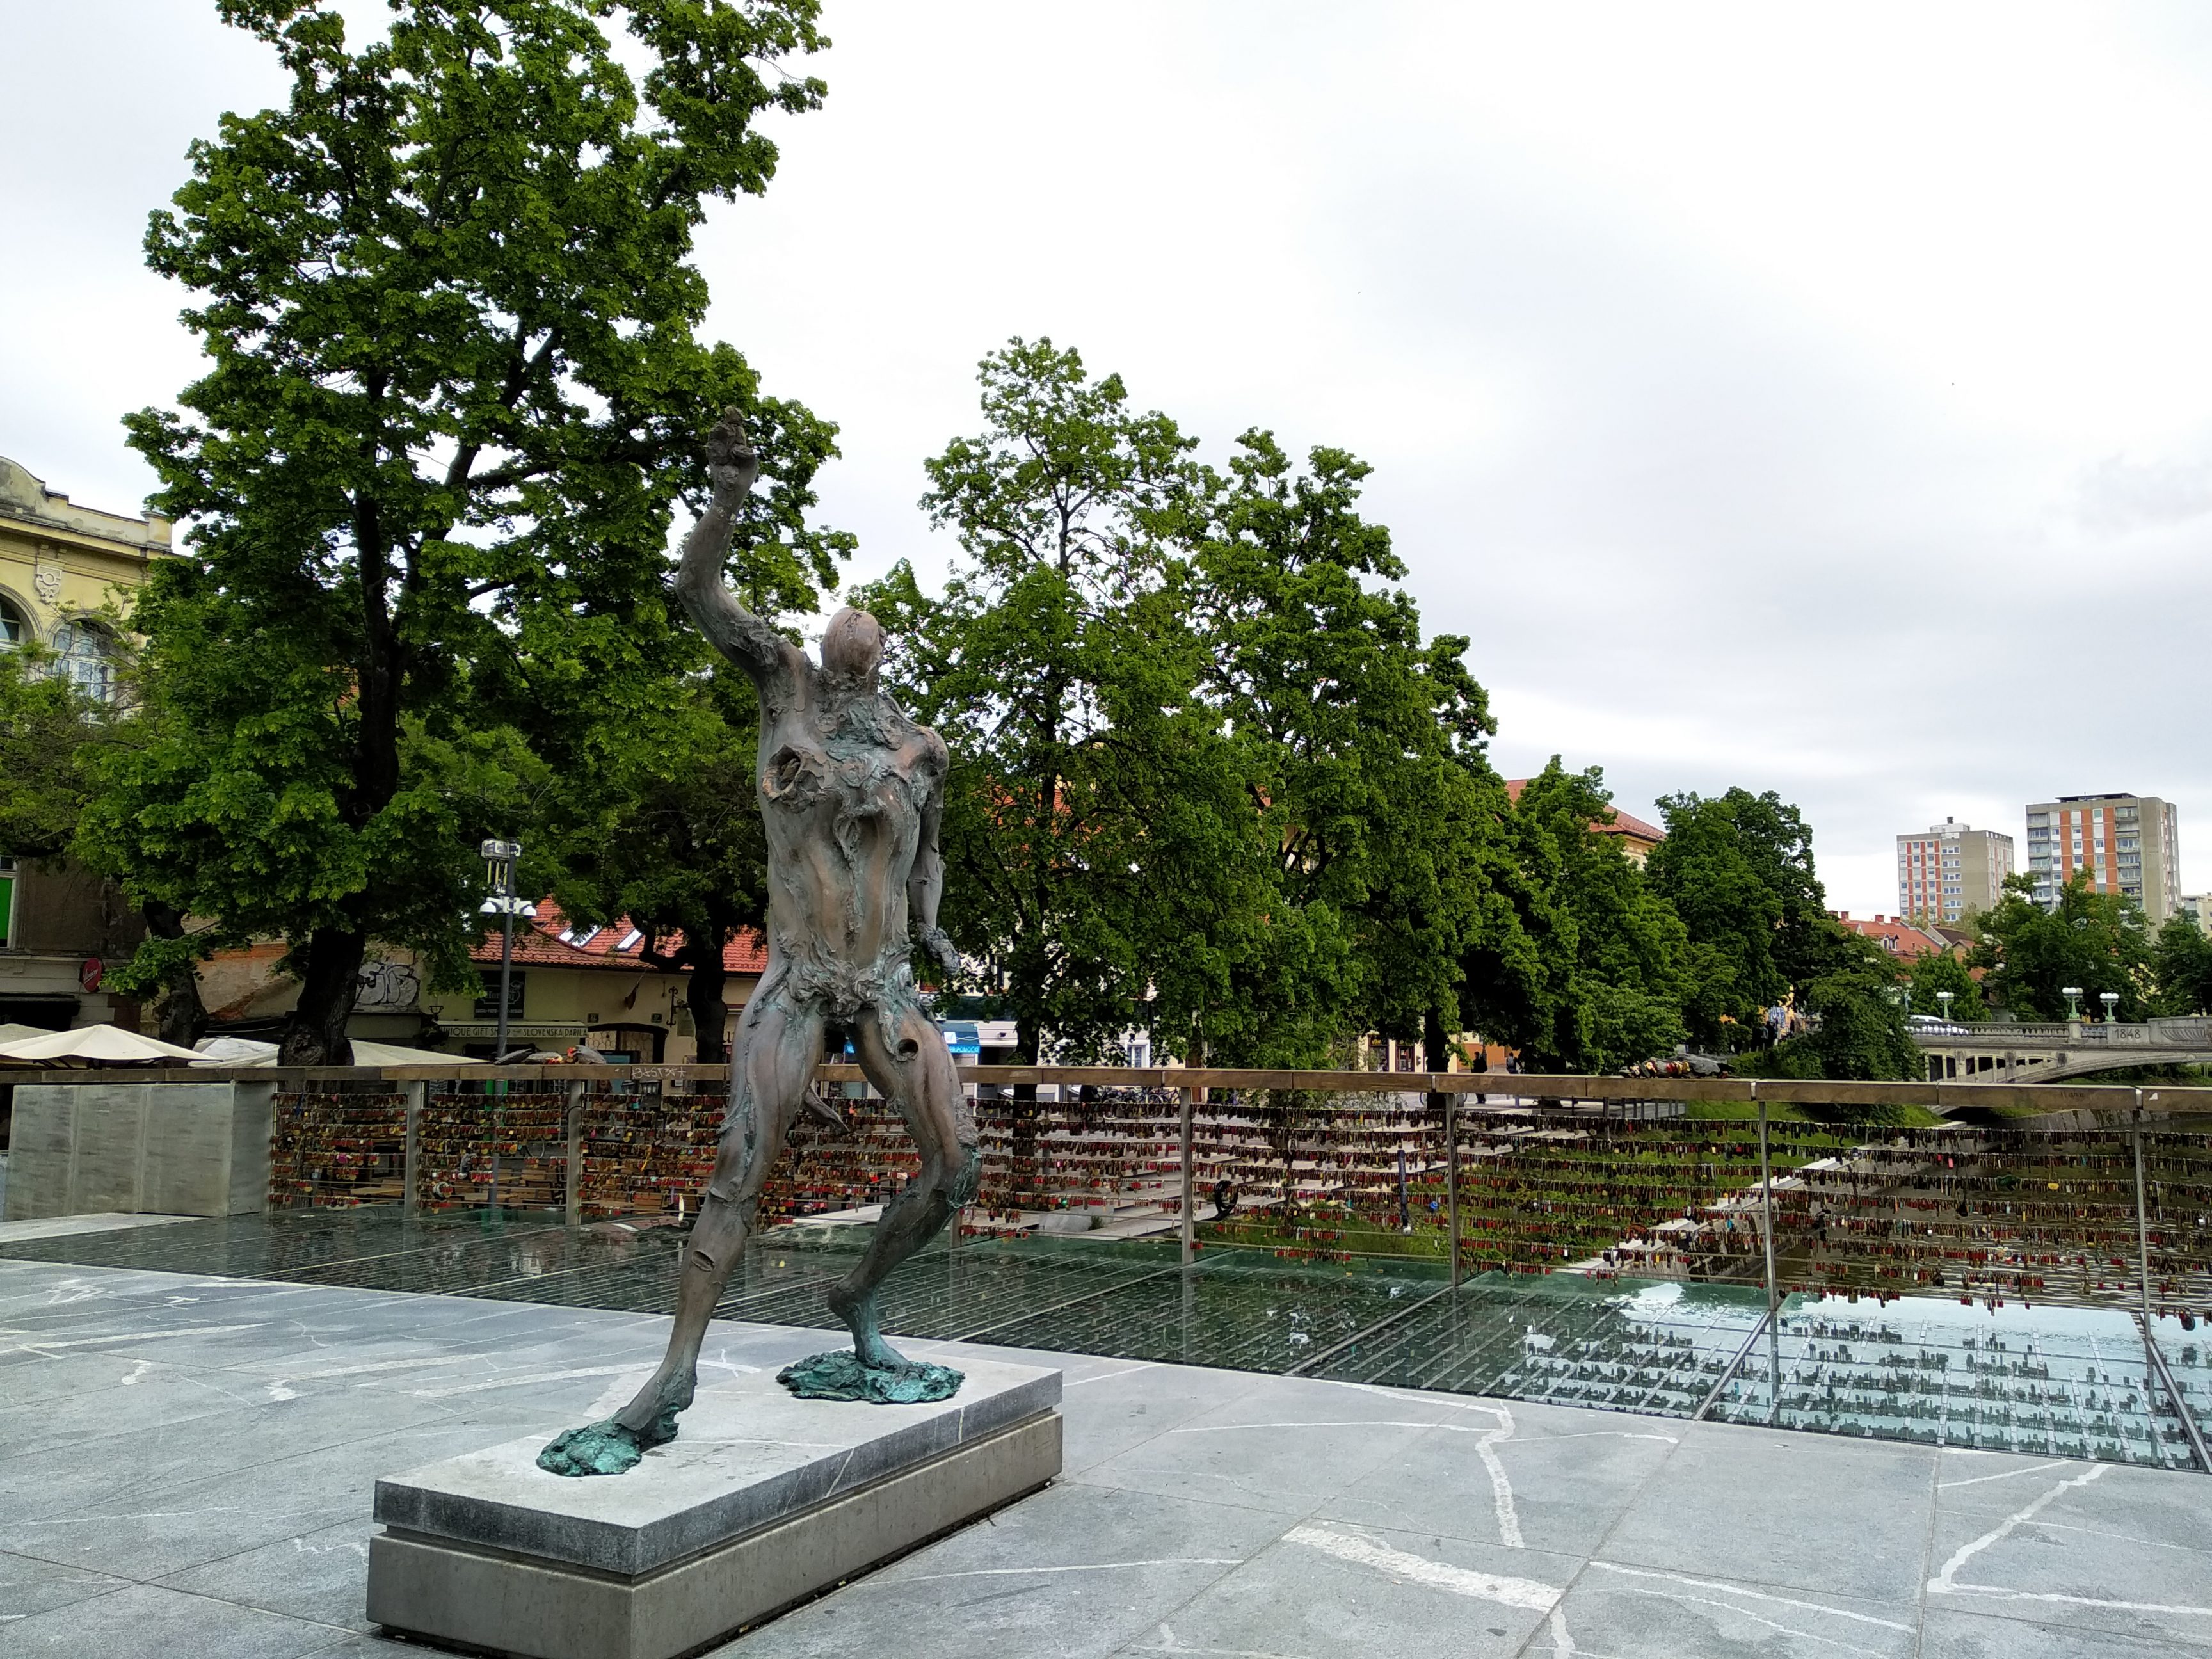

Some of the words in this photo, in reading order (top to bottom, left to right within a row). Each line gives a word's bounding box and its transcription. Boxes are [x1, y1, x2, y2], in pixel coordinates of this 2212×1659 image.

[472, 1027, 488, 1036] GIFT
[490, 1027, 511, 1036] SHP
[523, 1028, 563, 1036] SLOVENSKA
[2114, 1028, 2141, 1039] 1848
